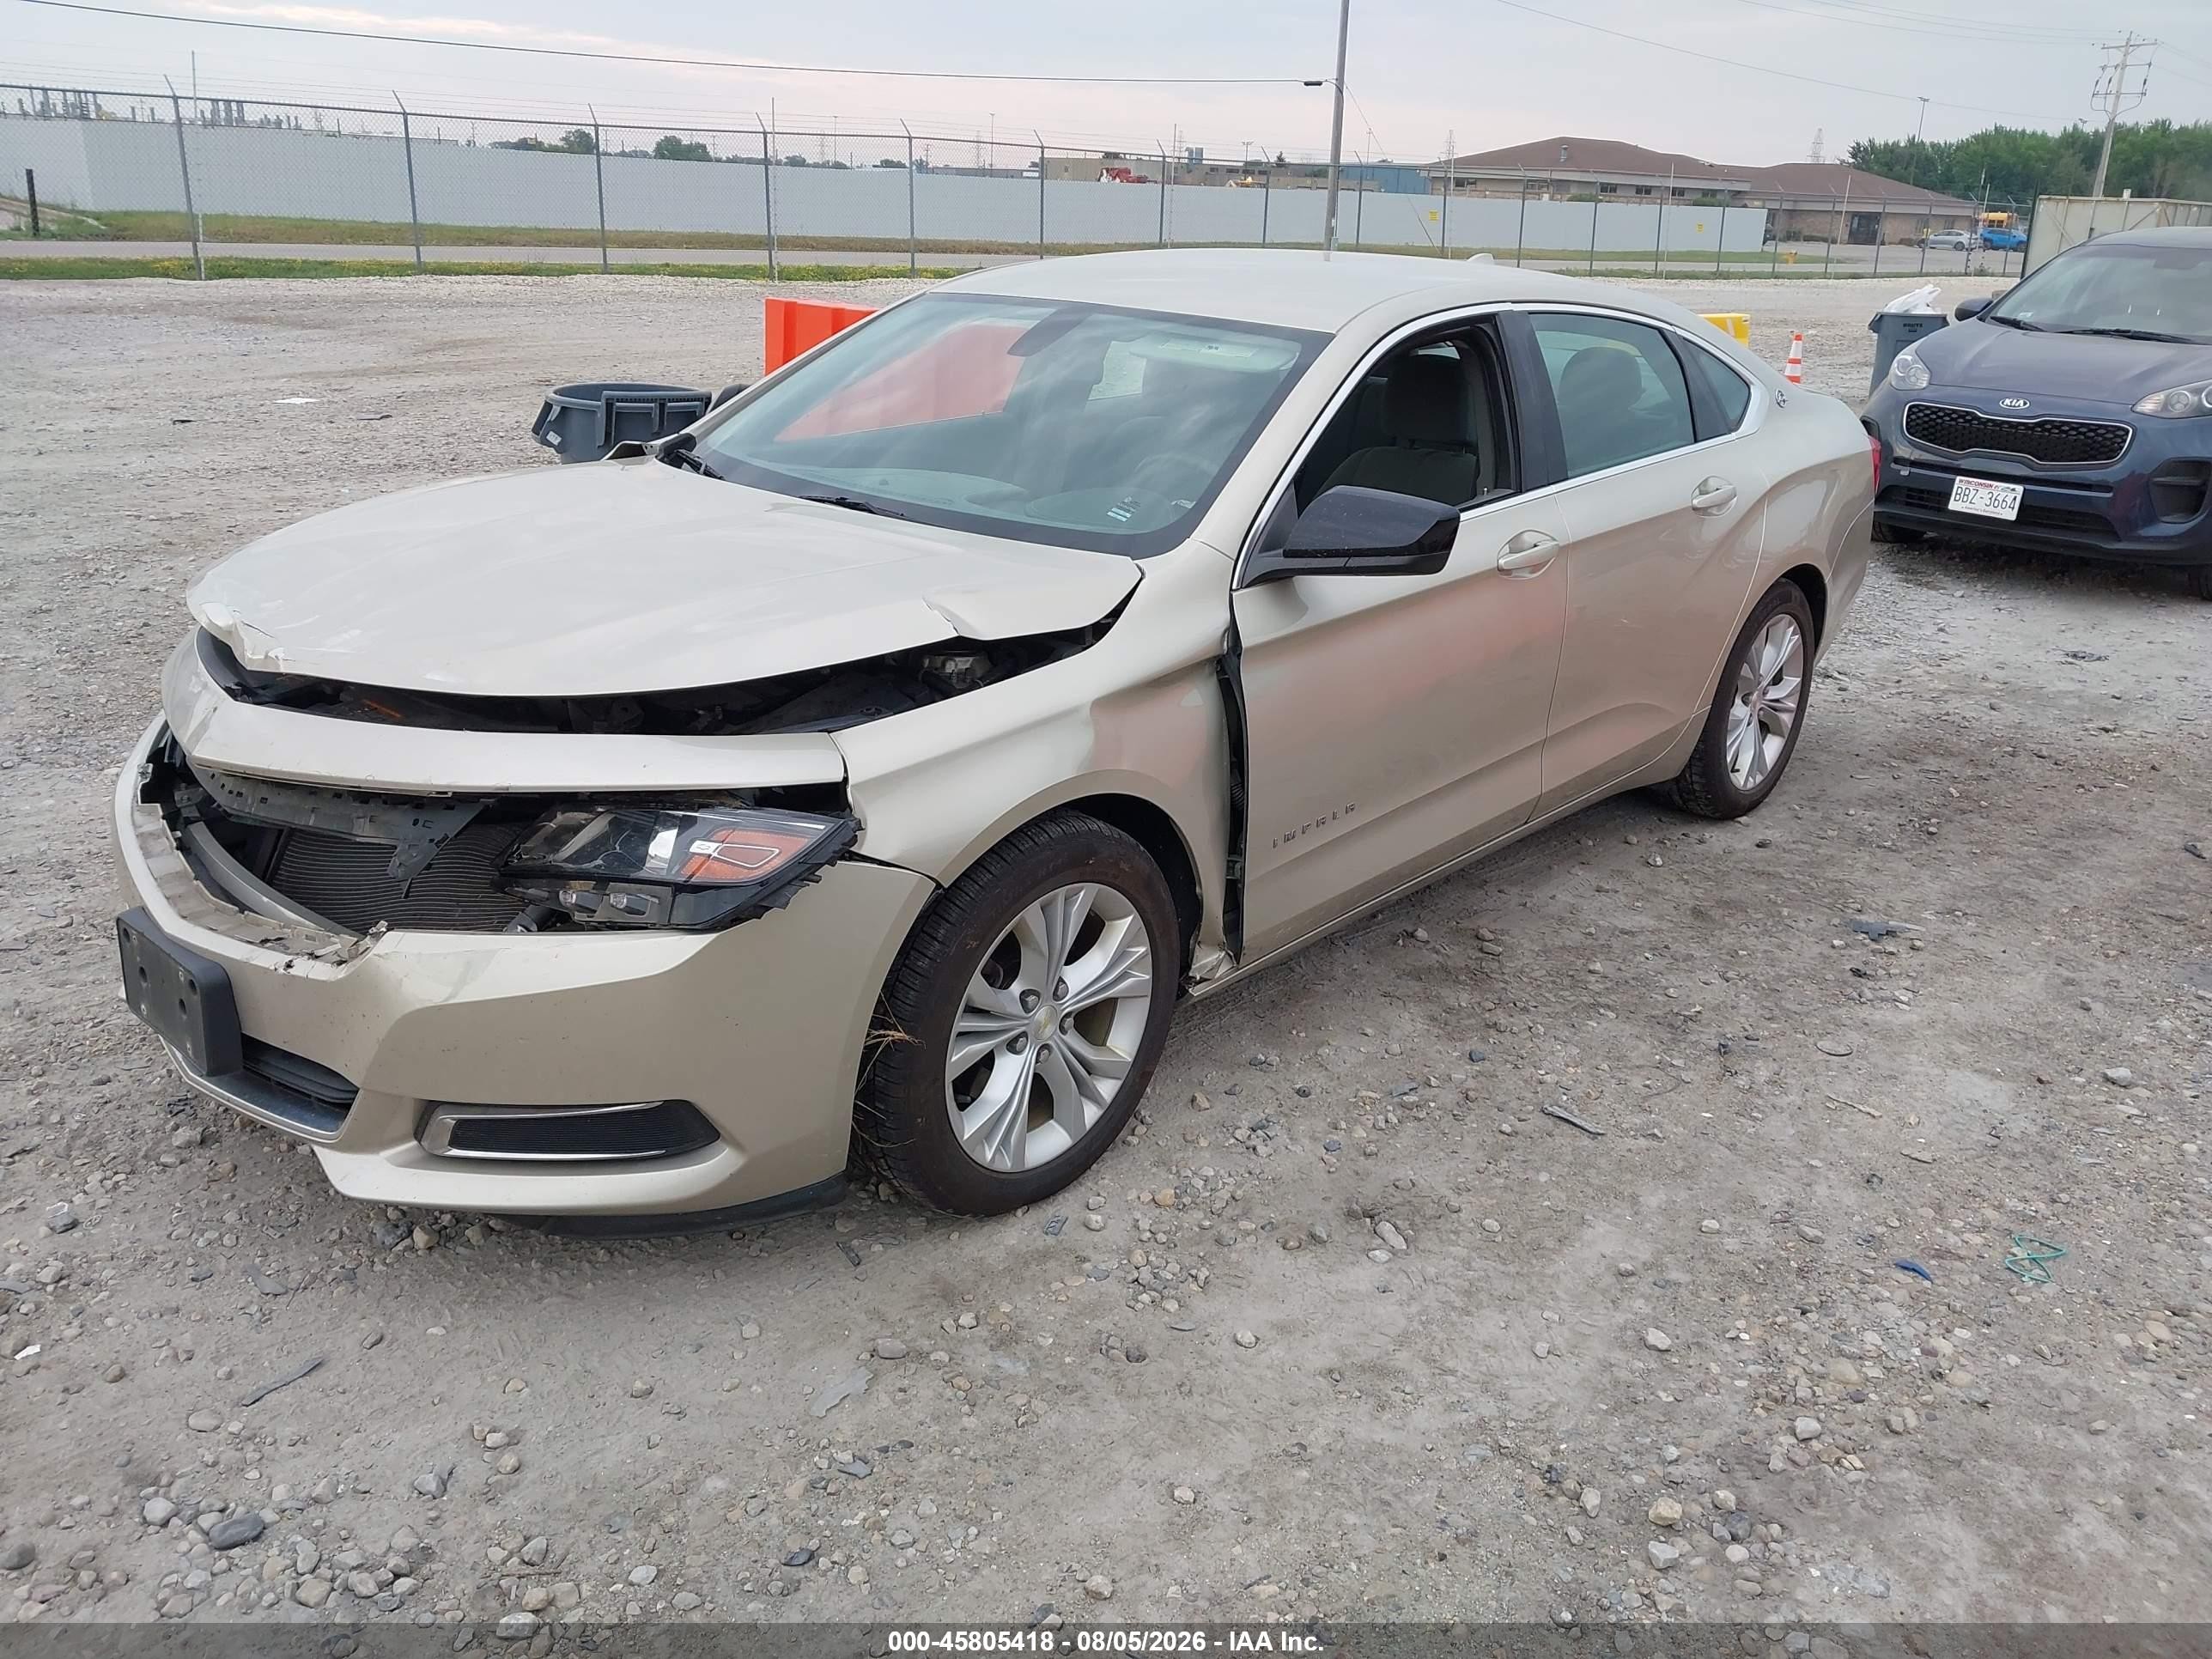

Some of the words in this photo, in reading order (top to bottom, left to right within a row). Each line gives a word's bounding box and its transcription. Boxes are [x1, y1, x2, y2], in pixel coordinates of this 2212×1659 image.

[2003, 398, 2024, 407] KIA
[1958, 477, 1994, 489] WISCONSIN
[1953, 485, 2017, 512] BBZ-3664
